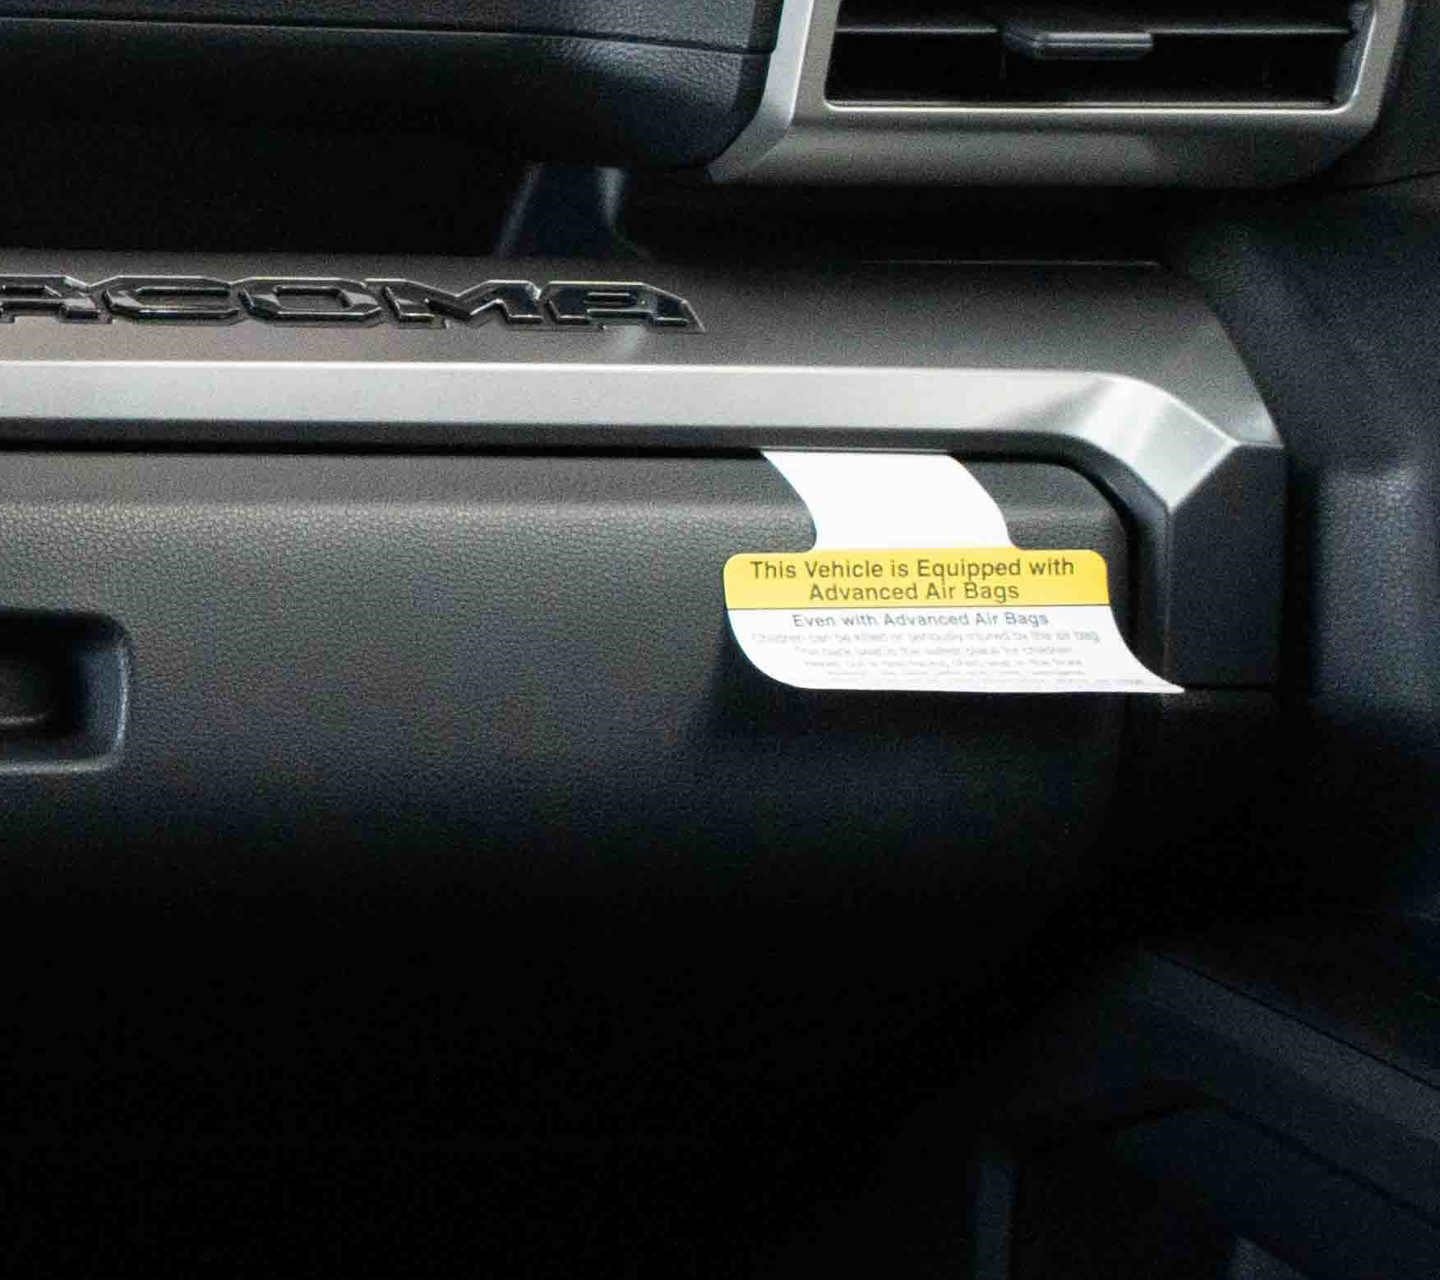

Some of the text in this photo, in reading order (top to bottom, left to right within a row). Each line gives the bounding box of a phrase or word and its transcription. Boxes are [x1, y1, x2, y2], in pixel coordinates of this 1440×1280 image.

[750, 557, 1075, 581] This Vehicle is Equipped with
[809, 581, 1021, 604] Advanced Air Bags
[791, 611, 1050, 628] Even with Advanced Air Bags
